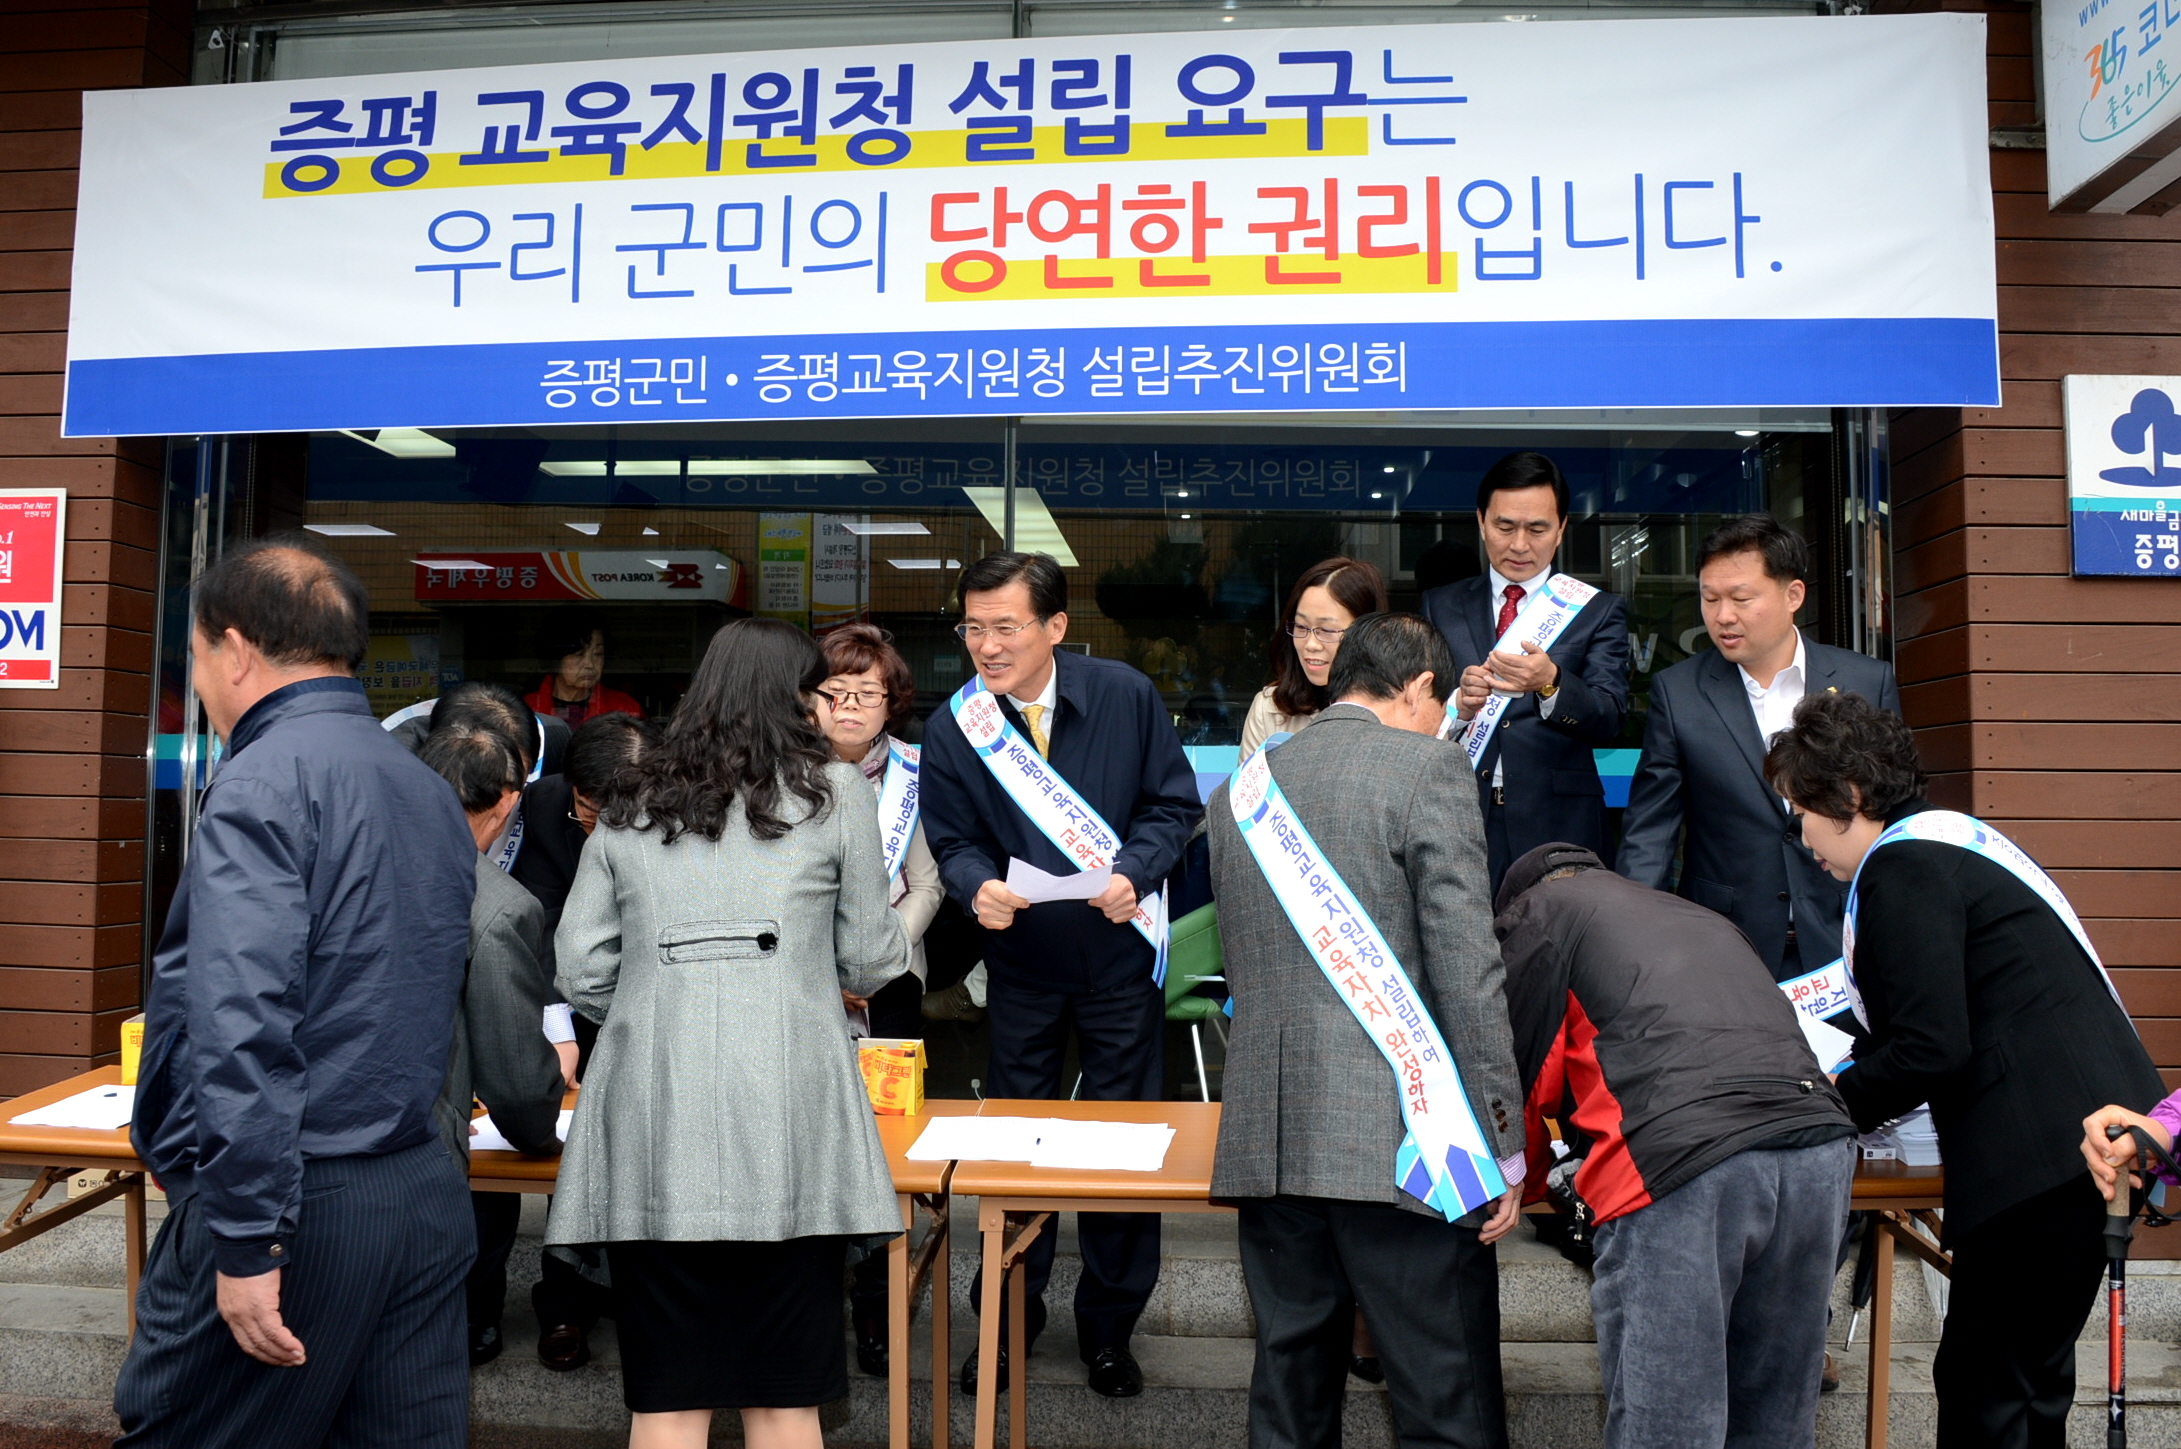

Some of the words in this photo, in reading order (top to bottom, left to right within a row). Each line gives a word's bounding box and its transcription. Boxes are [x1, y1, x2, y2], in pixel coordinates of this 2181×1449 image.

[2084, 26, 2127, 101] 365
[270, 90, 437, 193] 증평
[459, 63, 913, 177] 교육지원청
[948, 54, 1132, 163] 설립
[1165, 49, 1468, 152] 요구는
[415, 203, 583, 308] 우리
[615, 190, 888, 300] 군민의
[930, 181, 1223, 293] 당연한
[1248, 172, 1783, 286] 권리입니다.
[540, 355, 708, 409] 증평군민
[753, 345, 1067, 404] 증평교육지원청
[1082, 341, 1407, 398] 설립추진위원회
[2120, 500, 2180, 531] 새마을금
[2134, 534, 2180, 569] 증평
[1006, 743, 1112, 851] 증평교육지원청
[1268, 809, 1385, 969] 증평교육지원청
[1381, 978, 1441, 1064] 설립하여
[1311, 925, 1392, 1022] 교육자치
[1384, 1028, 1429, 1116] 완성하자
[1782, 975, 1830, 1002] 교육
